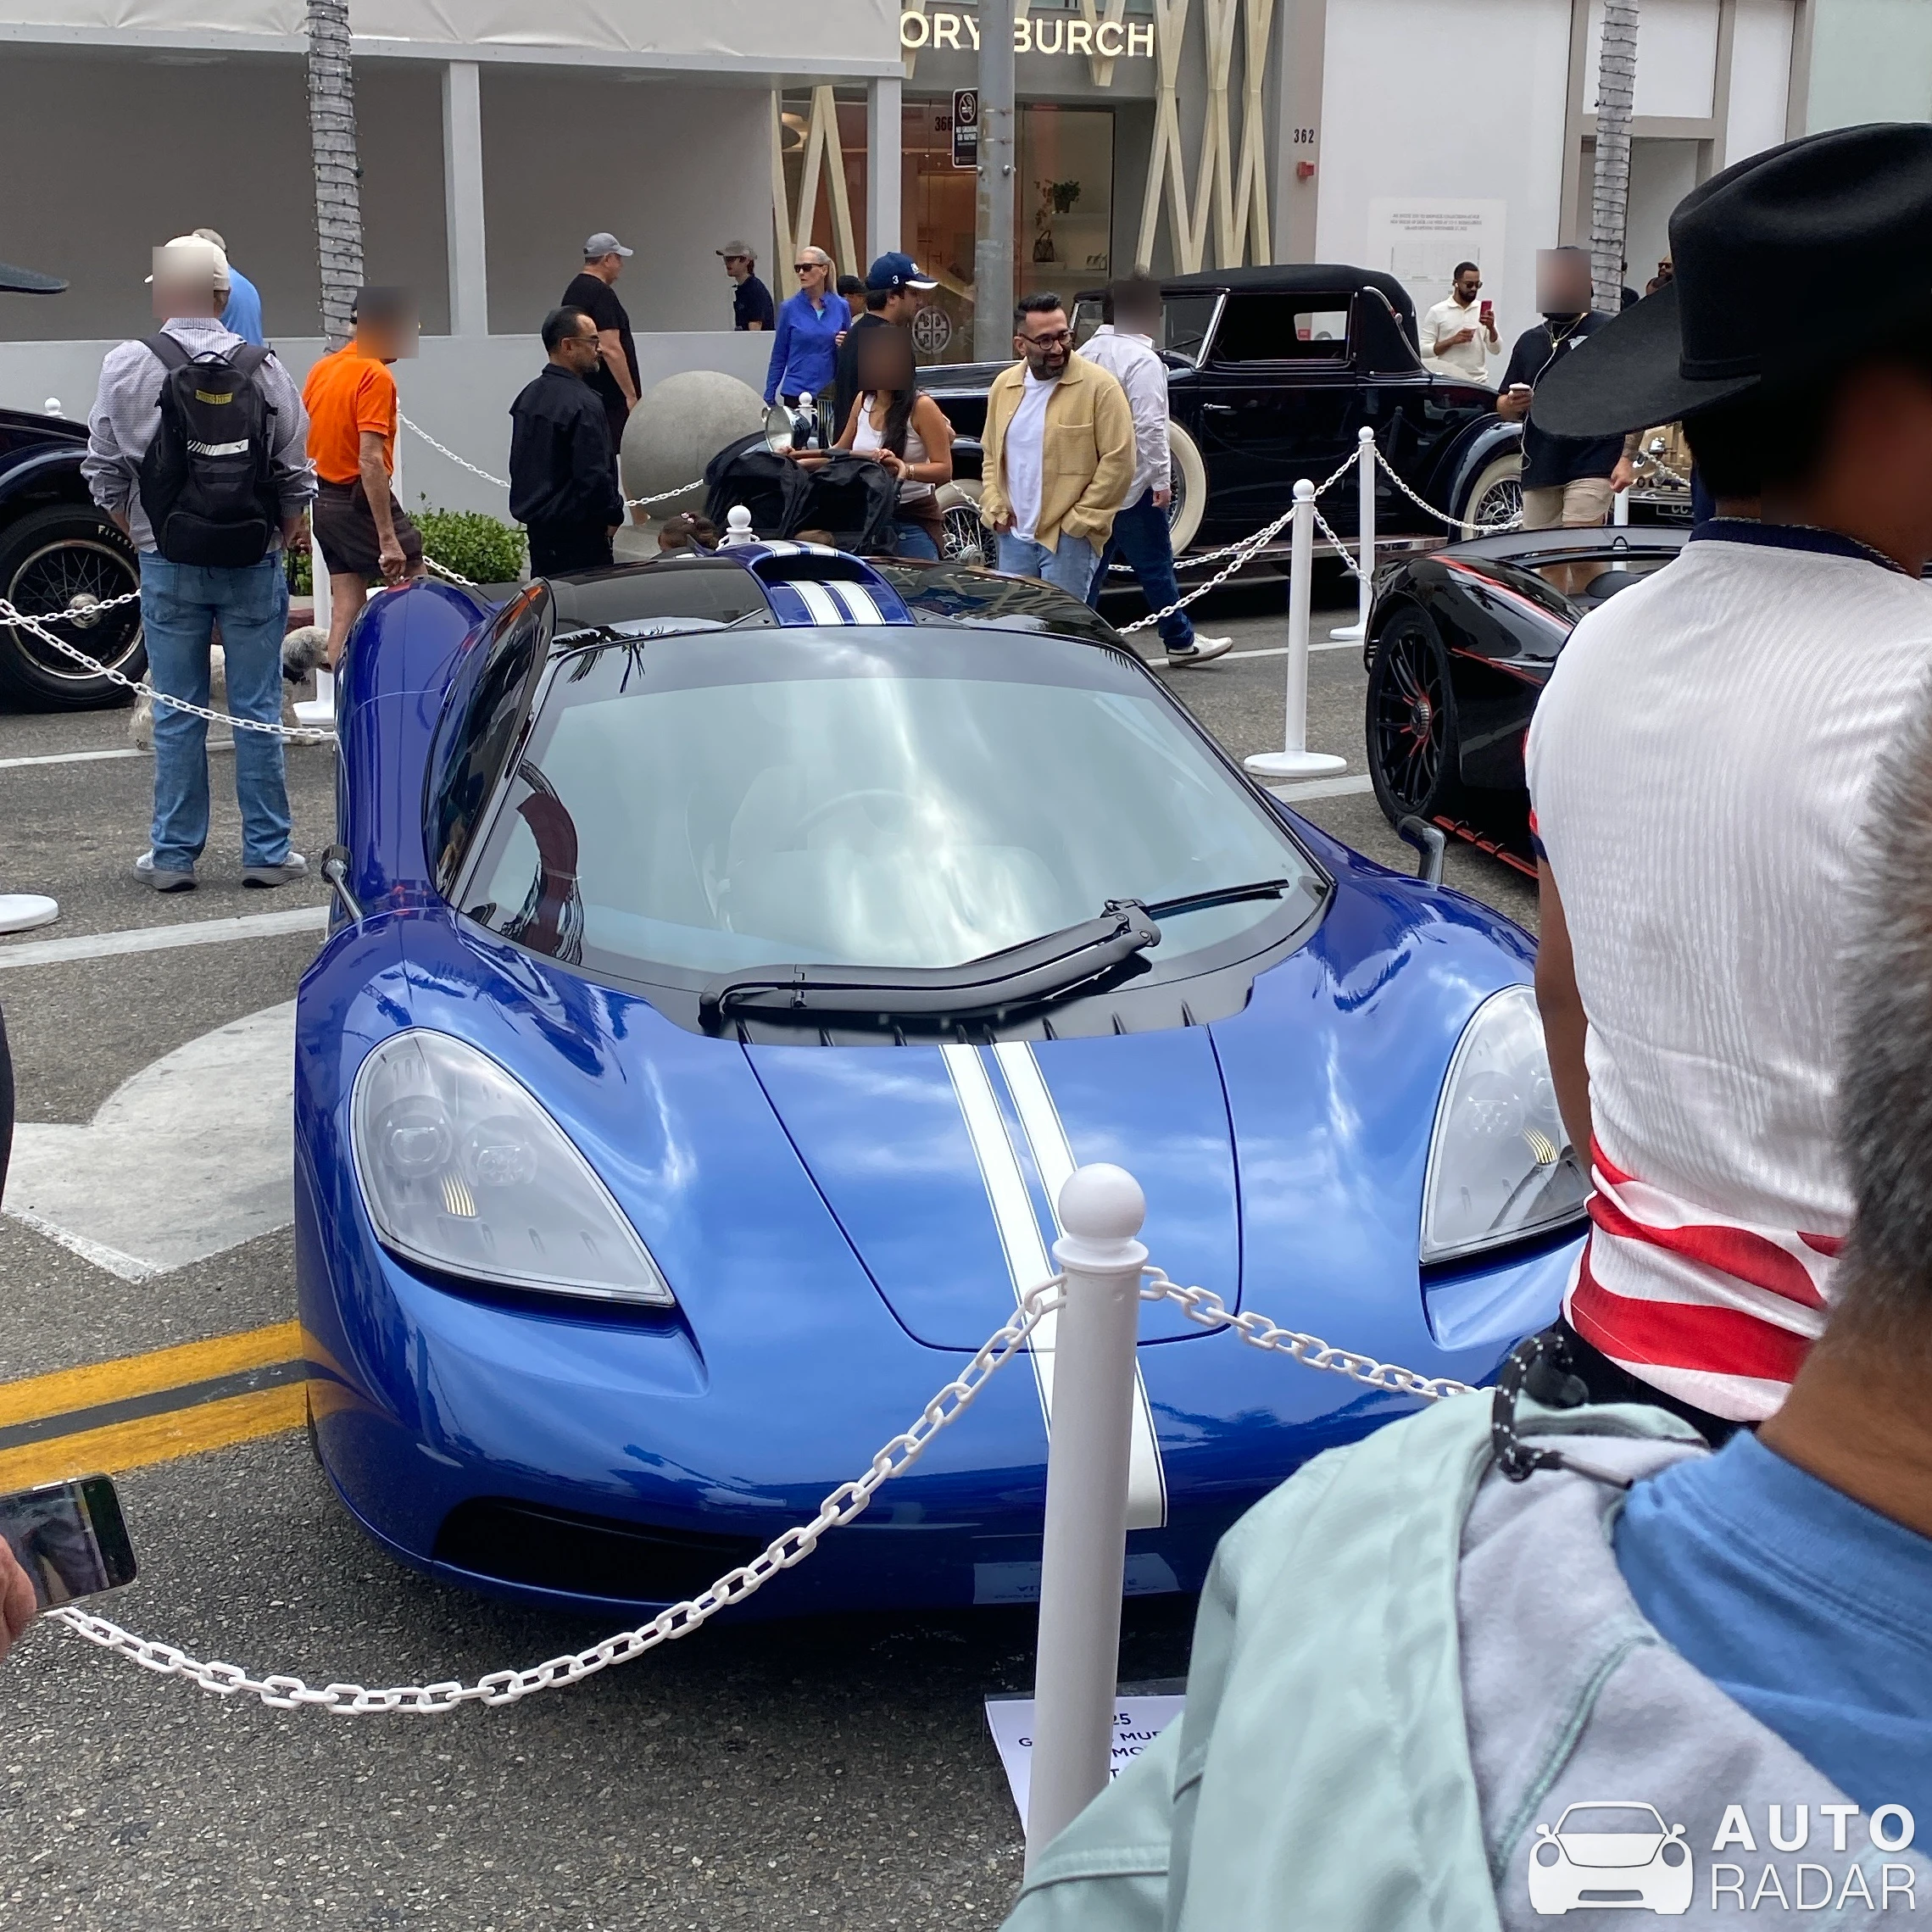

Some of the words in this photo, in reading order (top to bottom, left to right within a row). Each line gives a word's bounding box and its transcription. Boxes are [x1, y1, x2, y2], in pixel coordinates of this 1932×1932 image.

[899, 10, 980, 50] ORY
[1013, 18, 1155, 58] BURCH
[1294, 128, 1314, 143] 362
[892, 275, 899, 285] 3
[97, 525, 134, 550] Firest
[1113, 1712, 1132, 1725] 25
